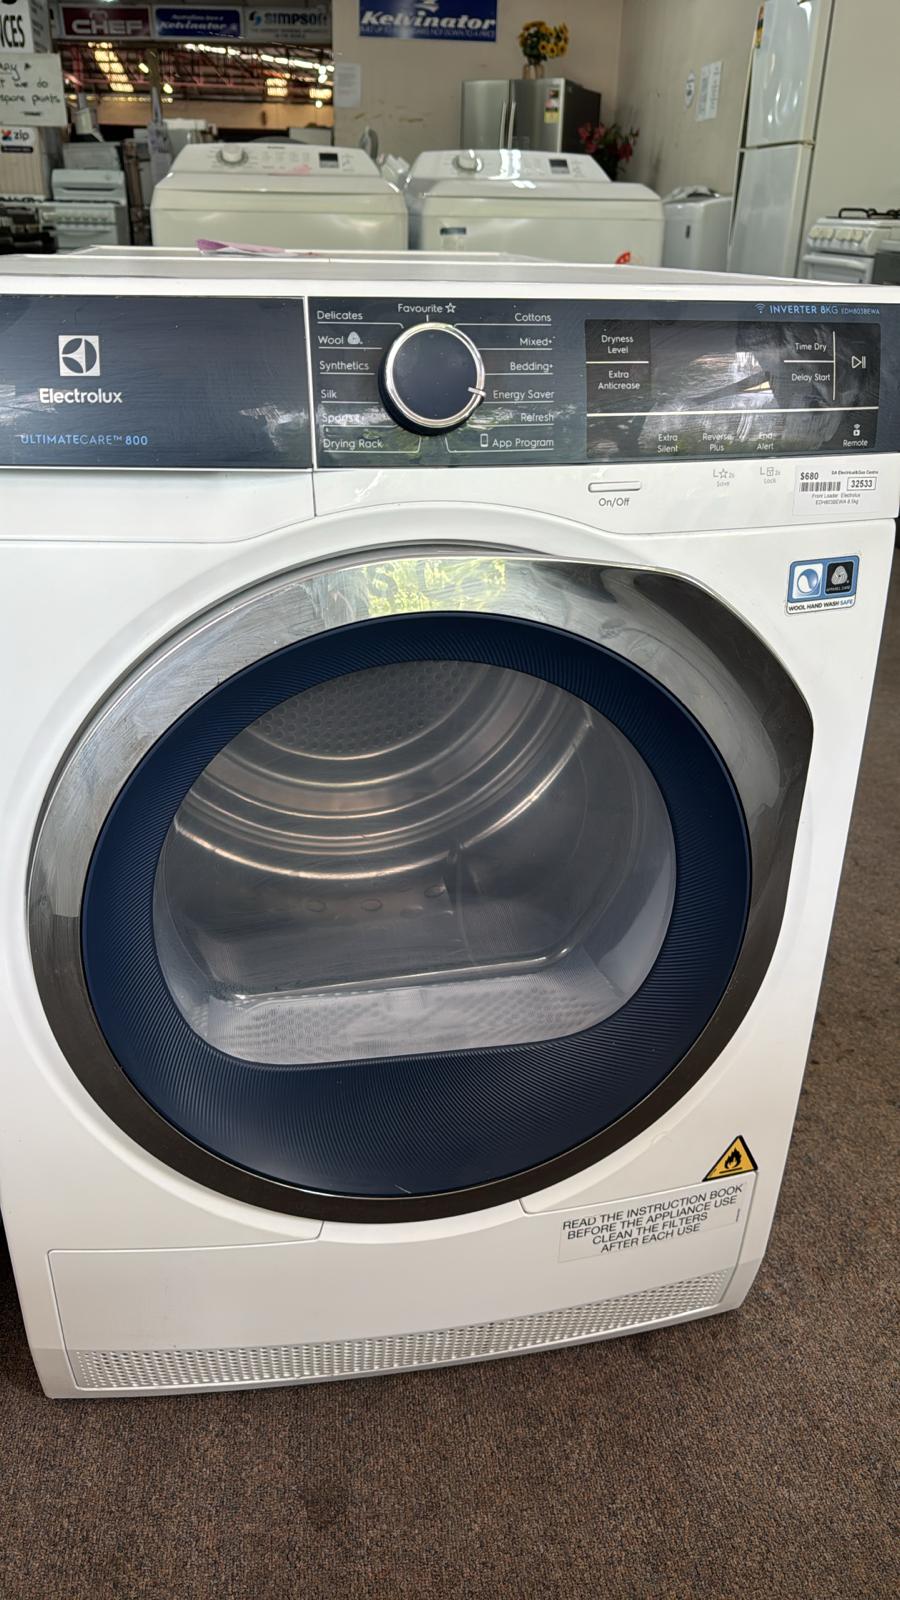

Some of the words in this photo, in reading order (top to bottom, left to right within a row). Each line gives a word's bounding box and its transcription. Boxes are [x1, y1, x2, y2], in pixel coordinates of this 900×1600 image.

[360, 10, 496, 30] Kelvinator
[71, 17, 144, 34] CHEF
[14, 129, 30, 141] zip
[398, 303, 443, 314] Favourite
[769, 304, 817, 314] INVERTER
[820, 304, 838, 314] 8KG
[316, 310, 363, 321] Delicates
[514, 312, 552, 322] Cottons
[318, 336, 344, 345] Wool
[601, 334, 634, 346] Dryness
[608, 344, 628, 354] Level
[795, 342, 812, 351] Time
[813, 342, 828, 352] Dry
[319, 361, 370, 371] Synthetics
[608, 370, 630, 380] Extra
[791, 373, 812, 383] Delay
[814, 373, 830, 382] Start
[598, 381, 640, 390] Anticrease
[39, 388, 122, 404] Electrolux
[320, 389, 337, 398] Silk
[493, 390, 525, 401] Energy
[528, 390, 554, 399] Saver
[520, 412, 554, 422] Refresh
[125, 435, 148, 446] 800
[658, 433, 678, 442] Extra
[702, 432, 732, 442] Reverse
[758, 432, 773, 440] End
[323, 439, 356, 451] Drying
[358, 439, 384, 448] Rack
[492, 438, 513, 448] App
[516, 438, 554, 448] Program
[756, 442, 774, 451] Alert
[843, 438, 868, 447] Remote
[657, 444, 678, 453] Silent
[709, 444, 724, 452] Plus
[800, 472, 819, 480] $680
[850, 480, 873, 488] 32533
[598, 498, 630, 508] On/Off
[806, 602, 822, 610] HAND
[840, 598, 854, 606] SAFE
[562, 1216, 598, 1231] READ
[600, 1210, 625, 1224] THE
[626, 1192, 708, 1220] INSTRUCTION
[708, 1184, 744, 1200] BOOK
[567, 1222, 617, 1240] BEFORE
[620, 1217, 644, 1231] THE
[646, 1201, 712, 1225] APPLIANCE
[714, 1195, 738, 1209] USE
[592, 1230, 634, 1245] CLEAN
[636, 1224, 660, 1236] THE
[662, 1212, 708, 1231] FILTERS
[600, 1239, 639, 1254] AFTER
[641, 1231, 674, 1246] EACH
[676, 1224, 701, 1237] USE
